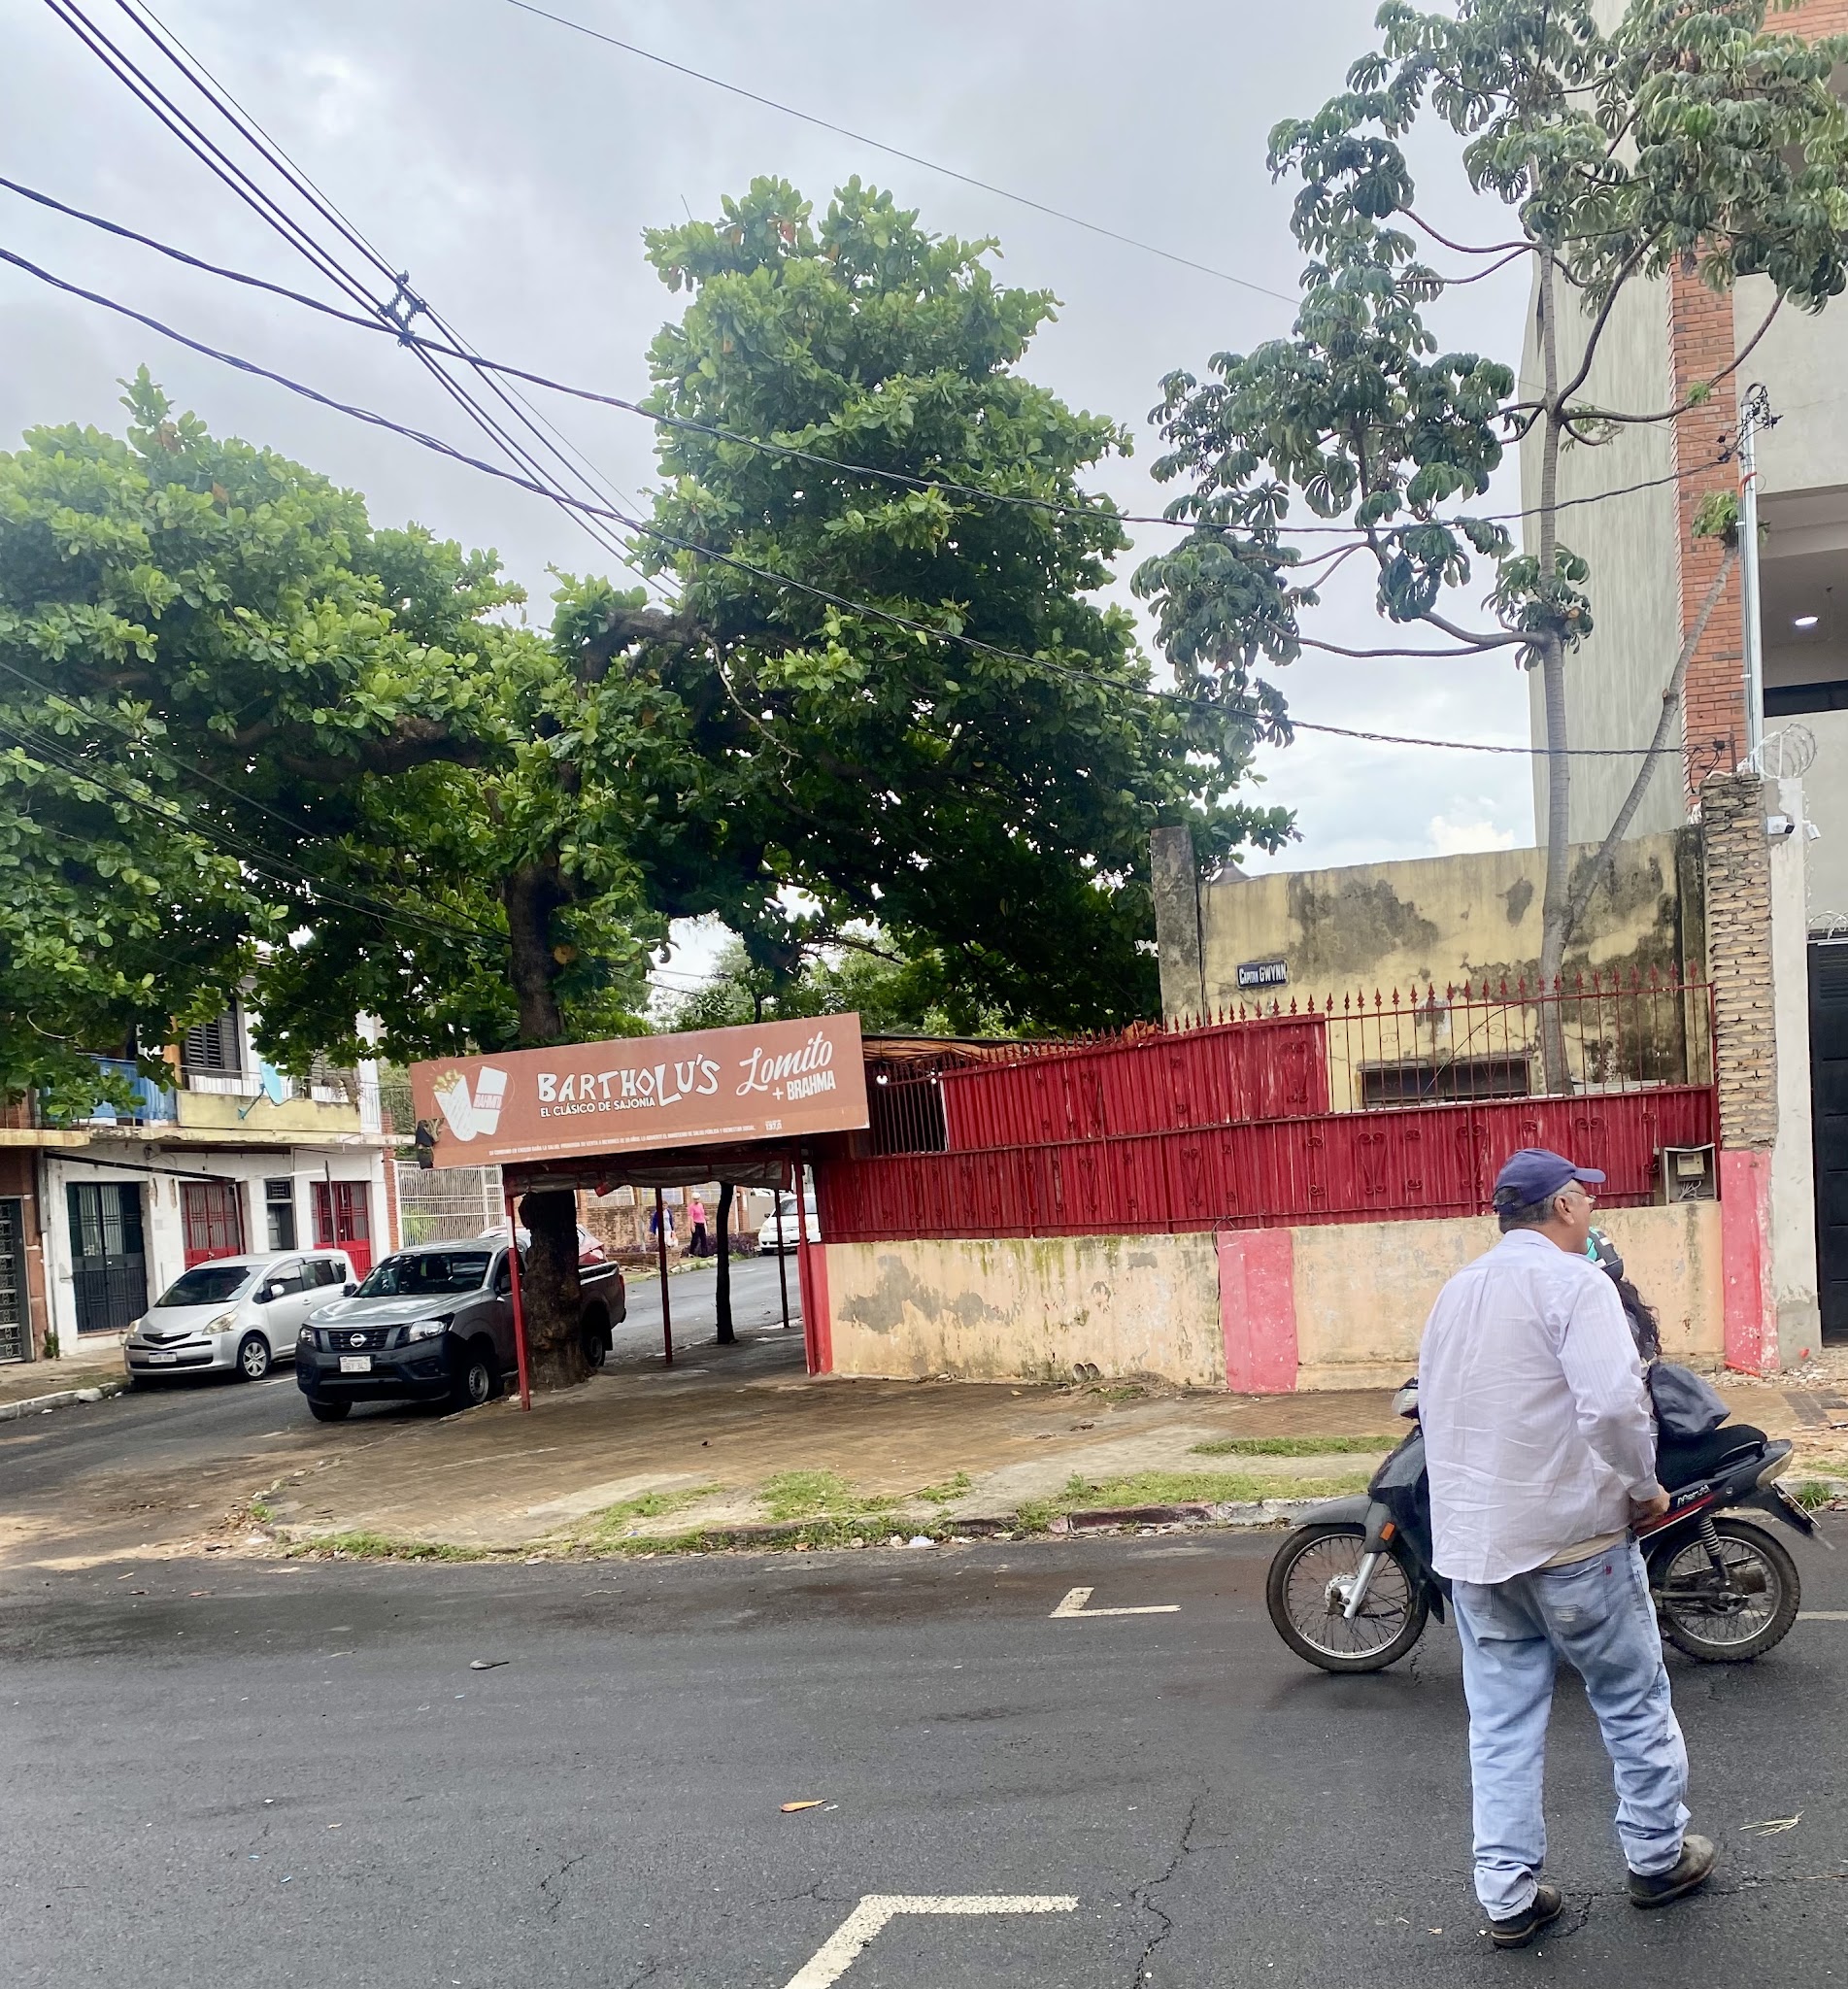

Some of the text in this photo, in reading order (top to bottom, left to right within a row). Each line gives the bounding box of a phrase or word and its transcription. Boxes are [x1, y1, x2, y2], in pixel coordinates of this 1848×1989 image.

[1259, 963, 1287, 983] GWYNN
[736, 1030, 833, 1096] Lomito
[537, 1053, 722, 1107] BARTHOLU'S
[786, 1069, 837, 1101] BRAHMA
[540, 1096, 656, 1118] EL CLÁSICO DE SAJONIA
